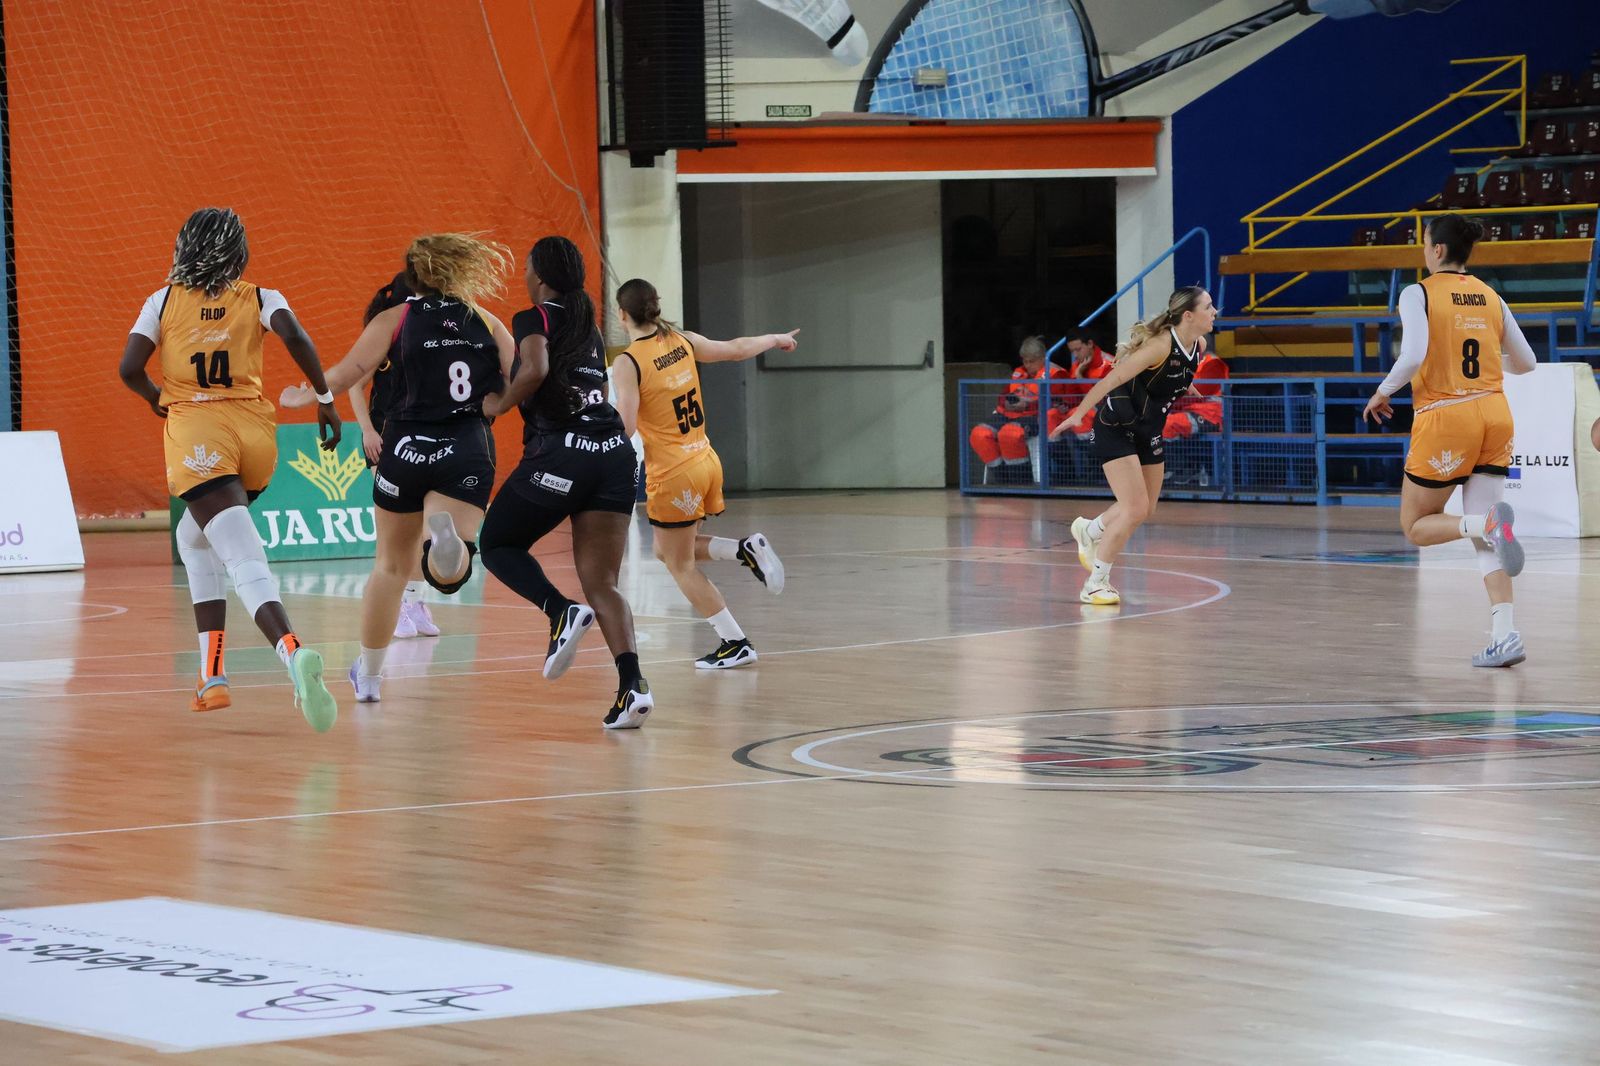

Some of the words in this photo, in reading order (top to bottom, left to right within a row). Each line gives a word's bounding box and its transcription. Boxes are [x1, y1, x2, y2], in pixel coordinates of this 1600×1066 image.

[1451, 292, 1487, 306] RELANCIO
[190, 350, 232, 388] 14
[652, 345, 688, 371] CARREGOSA
[1462, 338, 1480, 379] 8
[448, 360, 472, 402] 8
[672, 387, 704, 435] 55
[1526, 456, 1541, 466] LA
[1546, 456, 1569, 466] LUZ
[8, 944, 298, 987] recoletas
